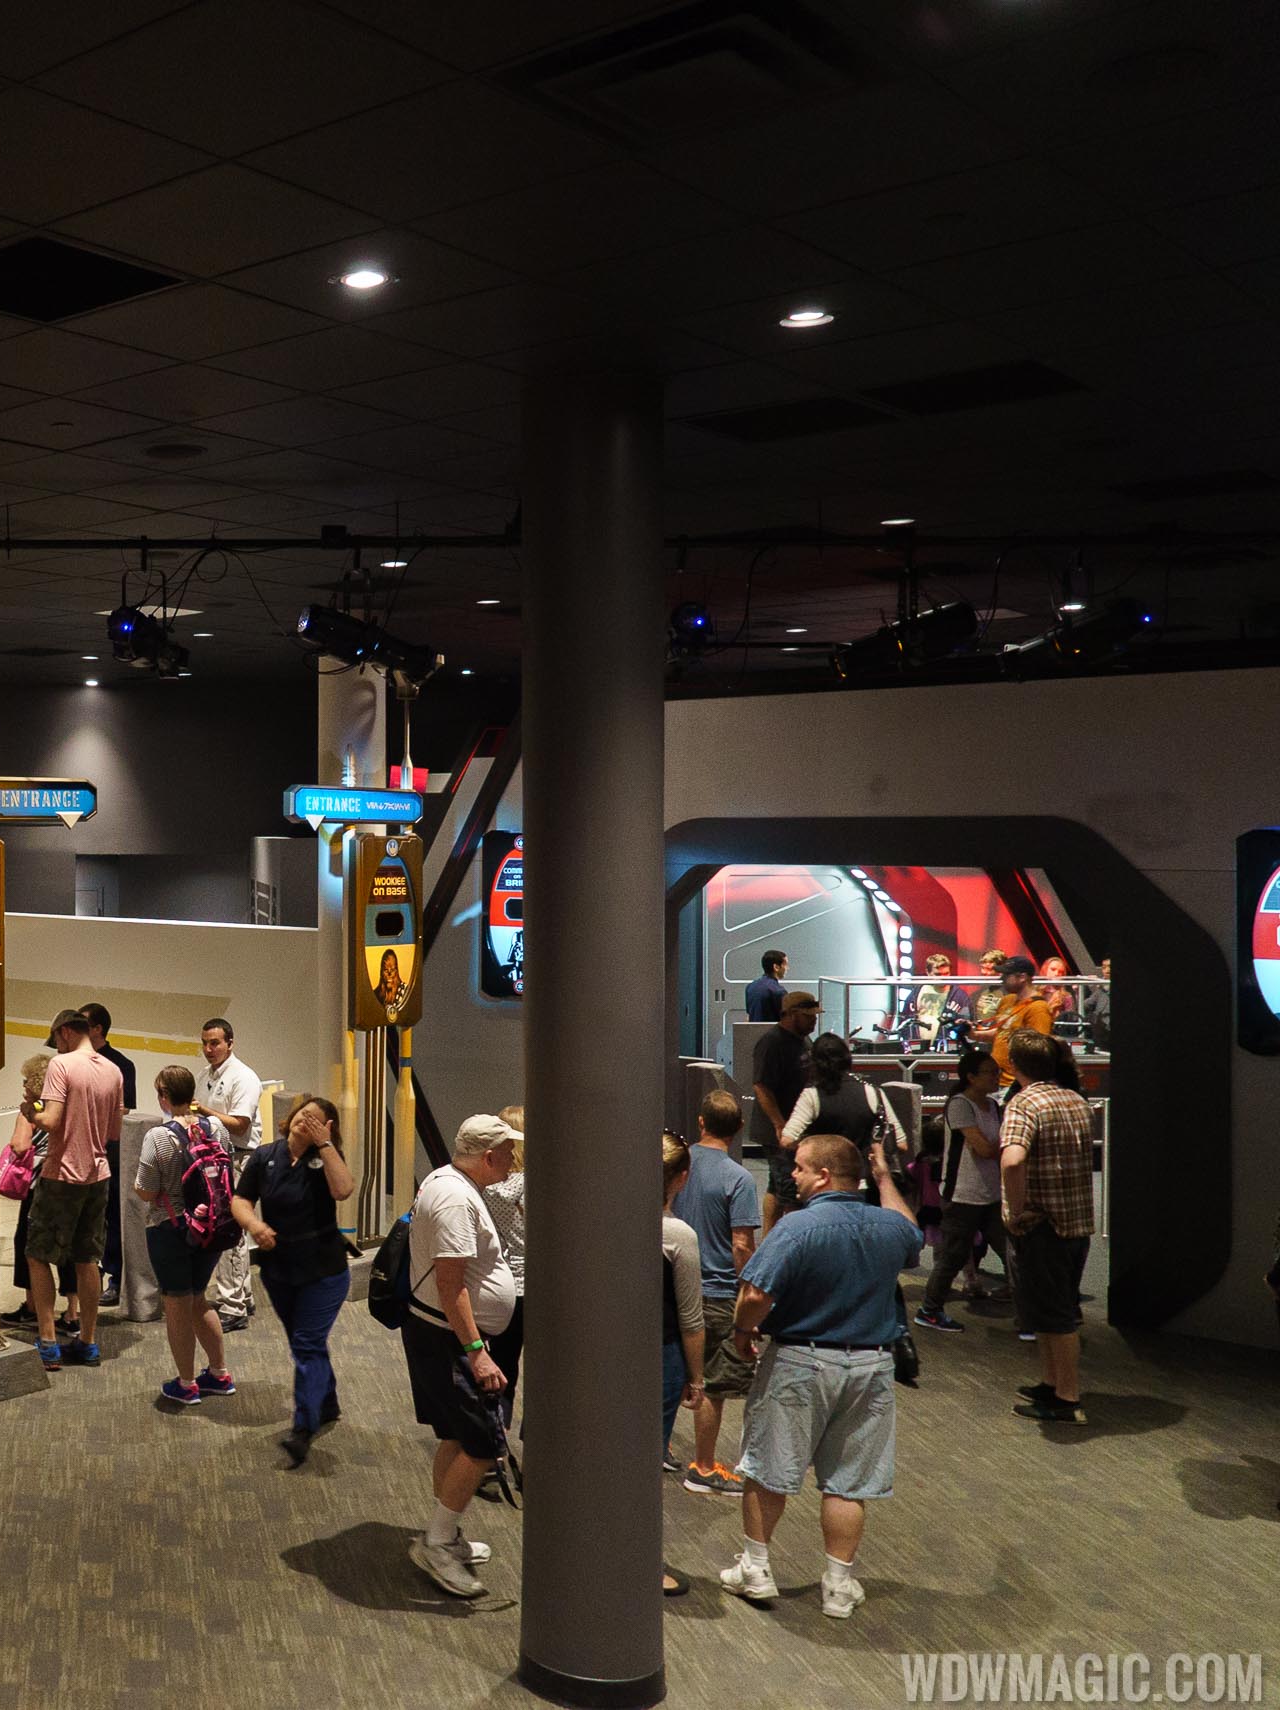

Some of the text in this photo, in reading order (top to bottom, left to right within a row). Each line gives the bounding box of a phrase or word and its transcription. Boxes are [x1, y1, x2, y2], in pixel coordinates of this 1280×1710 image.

[1, 790, 81, 808] ENTRANCE
[305, 795, 361, 812] ENTRANCE
[374, 876, 406, 886] WOOKIEE
